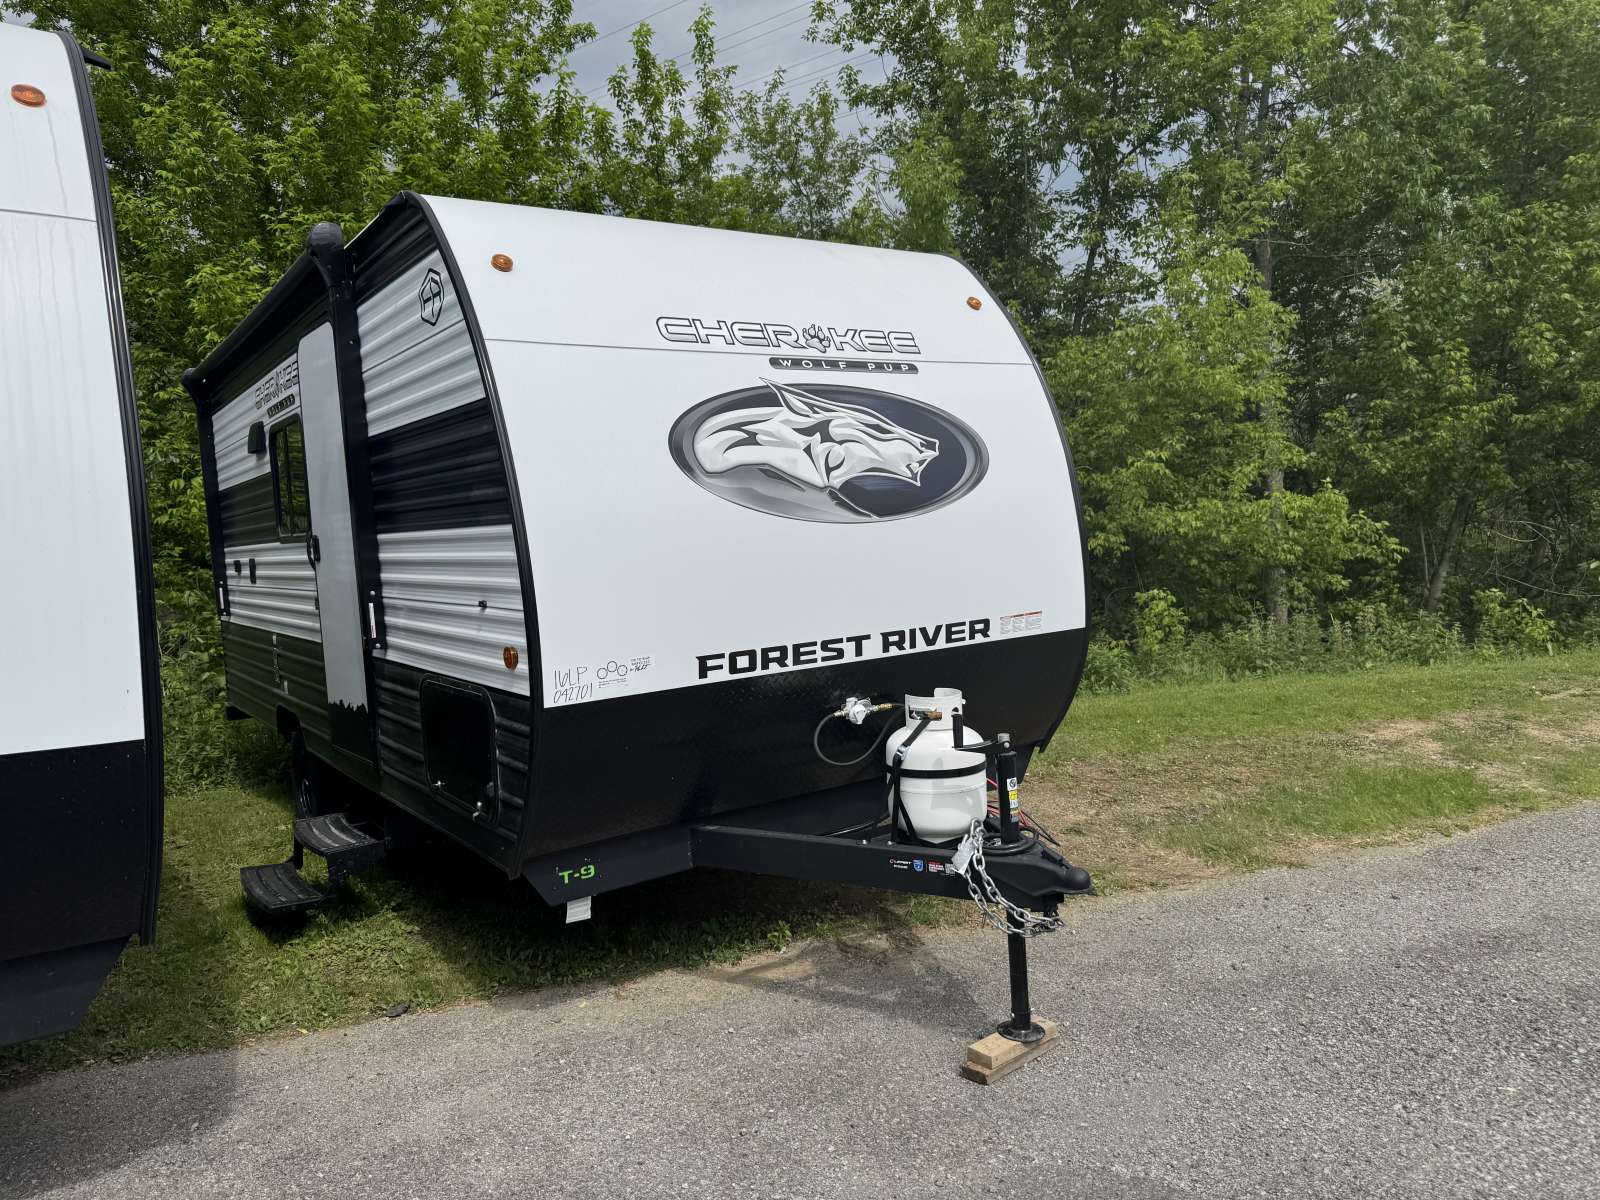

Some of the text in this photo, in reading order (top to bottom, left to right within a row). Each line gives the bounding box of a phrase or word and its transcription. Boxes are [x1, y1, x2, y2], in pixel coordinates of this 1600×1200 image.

[779, 359, 909, 372] WOLF PUP
[696, 634, 871, 680] FOREST
[880, 618, 991, 654] RIVER
[559, 864, 596, 884] T-9
